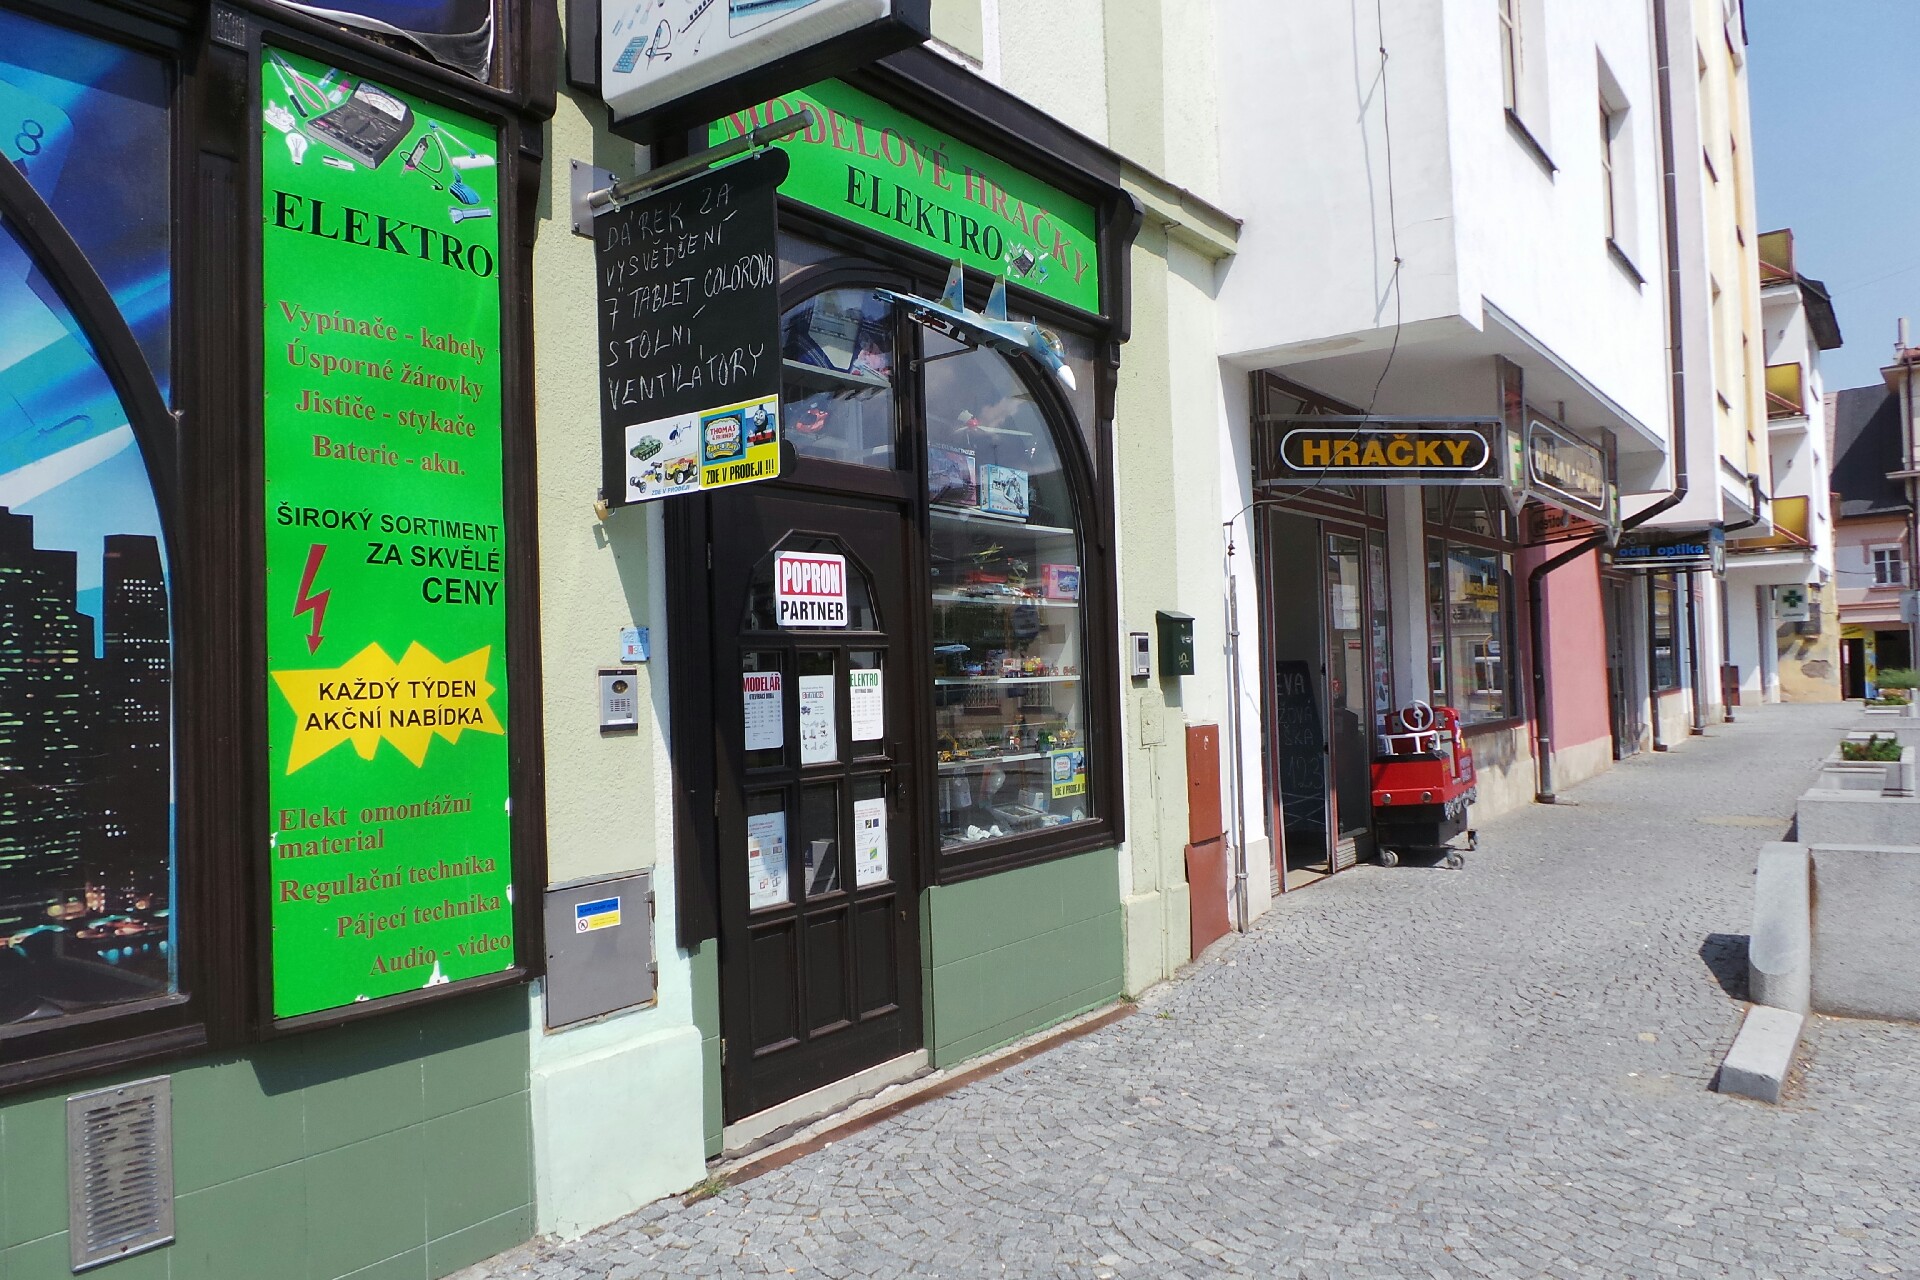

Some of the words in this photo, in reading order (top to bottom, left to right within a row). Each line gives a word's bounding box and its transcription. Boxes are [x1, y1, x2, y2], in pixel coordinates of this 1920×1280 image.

[722, 97, 951, 191] MODELOVÉ
[963, 166, 1090, 285] HRAČKY
[603, 203, 684, 252] DÁREK
[700, 183, 734, 215] ZA
[844, 164, 1003, 261] ELEKTRO
[272, 189, 493, 279] ELEKTRO
[629, 277, 696, 319] TABLET
[278, 300, 398, 341] Vypínače
[420, 327, 486, 365] kabely
[607, 305, 706, 367] STOLNÍ
[287, 338, 394, 381] Úsporné
[400, 362, 484, 403] žárovky
[608, 343, 764, 410] VENTILÁTORY
[295, 389, 376, 421] Jističe
[398, 408, 476, 438] stykače
[710, 425, 736, 435] THOMAS
[312, 434, 399, 467] Baterie
[421, 453, 466, 476] aku.
[1302, 433, 1470, 466] HRAČKY
[706, 468, 720, 485] ZDE
[722, 467, 727, 481] V
[730, 460, 763, 481] PRODEJI
[277, 501, 374, 531] ŠIROKÝ
[380, 514, 499, 543] SORTIMENT
[366, 542, 403, 566] ZA
[410, 544, 500, 573] SKVĚLÉ
[1657, 543, 1705, 558] optika
[422, 576, 499, 606] CENY
[782, 560, 841, 594] POPRON
[780, 600, 844, 621] PARTNER
[318, 677, 401, 701] KAŽDÝ
[408, 676, 476, 699] TÝDEN
[743, 673, 780, 692] MODELÁŘ
[850, 673, 879, 687] ELEKTRO
[305, 706, 382, 732] AKČNÍ
[389, 704, 484, 728] NABÍDKA
[278, 828, 384, 859] material
[279, 866, 402, 904] Regulační
[408, 855, 495, 886] technika
[336, 906, 407, 940] Pájecí
[413, 893, 501, 924] technika
[369, 945, 437, 976] Audio
[457, 932, 511, 957] video
